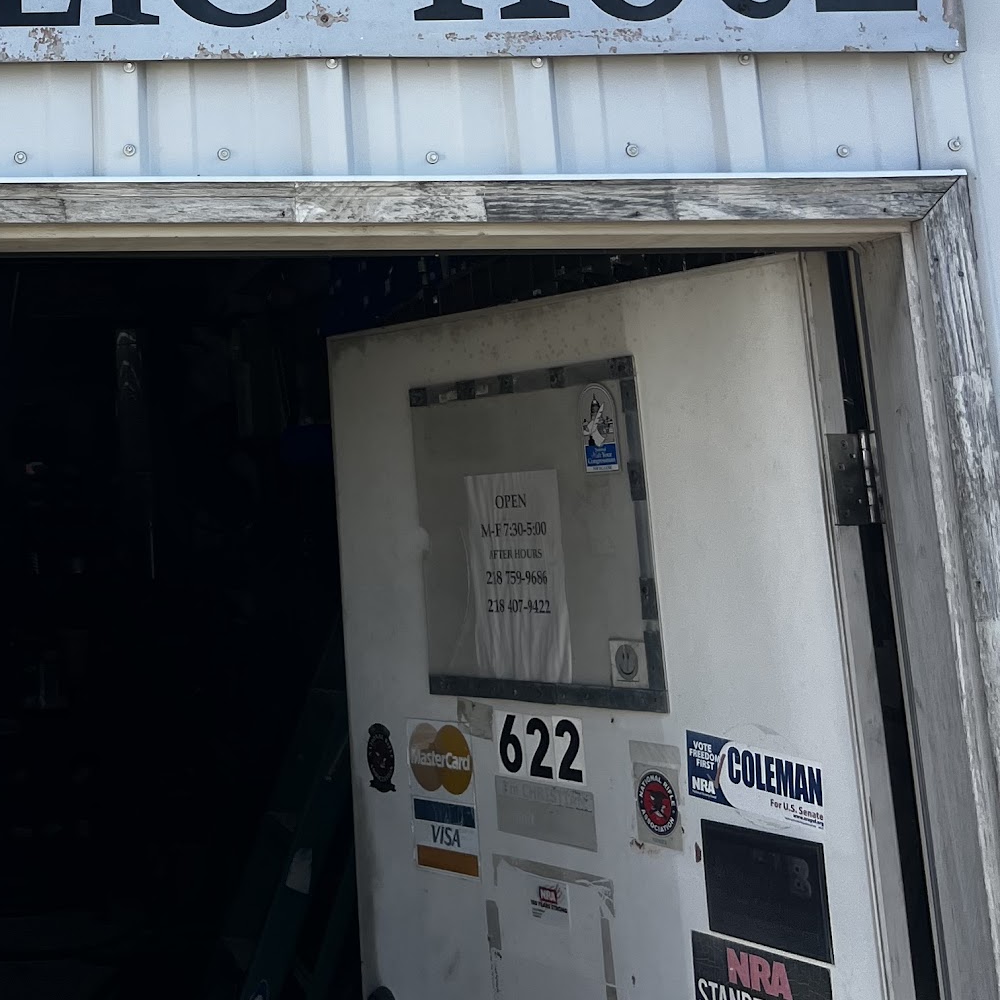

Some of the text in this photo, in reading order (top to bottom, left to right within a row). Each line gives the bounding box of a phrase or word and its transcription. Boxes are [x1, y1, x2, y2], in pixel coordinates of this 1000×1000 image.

[495, 494, 527, 509] OPEN
[503, 521, 547, 537] 7:30-5:00
[489, 549, 543, 560] AFTER HOURS
[486, 571, 548, 586] 218 759-9686
[488, 599, 551, 614] 218 407-9422
[499, 714, 584, 783] 622
[689, 748, 720, 763] FREEDOM
[692, 740, 712, 753] VOTE
[411, 747, 471, 771] MasterCard
[696, 758, 715, 770] FIRST
[691, 775, 716, 795] NRA
[727, 746, 823, 807] COLEMAN
[639, 774, 677, 807] NATIONAL RIFLE
[770, 798, 824, 821] For U.S. Senate
[640, 808, 676, 833] ASSOCIATION
[431, 824, 461, 848] VISA
[726, 947, 793, 1000] NRA
